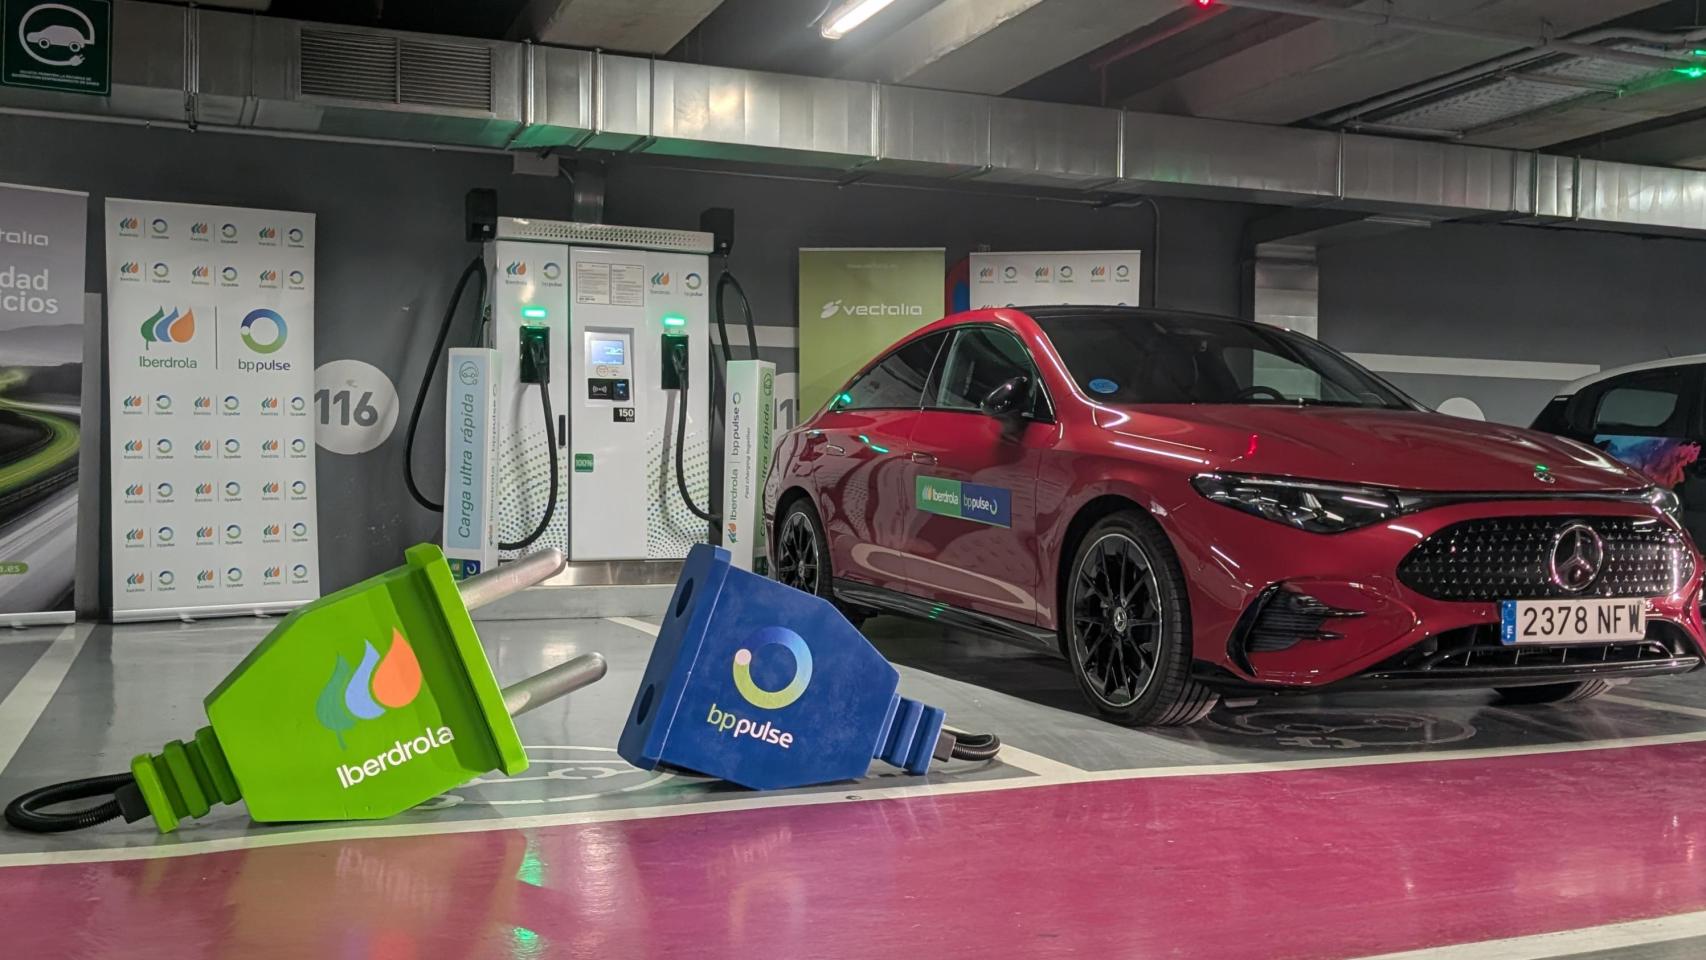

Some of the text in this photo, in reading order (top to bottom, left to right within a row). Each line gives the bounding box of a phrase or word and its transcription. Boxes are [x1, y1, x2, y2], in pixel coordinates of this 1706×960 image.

[0, 290, 58, 314] cios
[843, 303, 922, 316] vectalia
[139, 356, 197, 369] Iberdrola
[315, 389, 378, 427] 116
[618, 408, 634, 417] 150
[458, 393, 476, 538] Carga ultra rápida
[730, 469, 739, 520] Iberdrola
[932, 488, 959, 505] Iberdrola
[1523, 604, 1640, 636] 2378 NFW
[336, 726, 455, 788] Iberdrola
